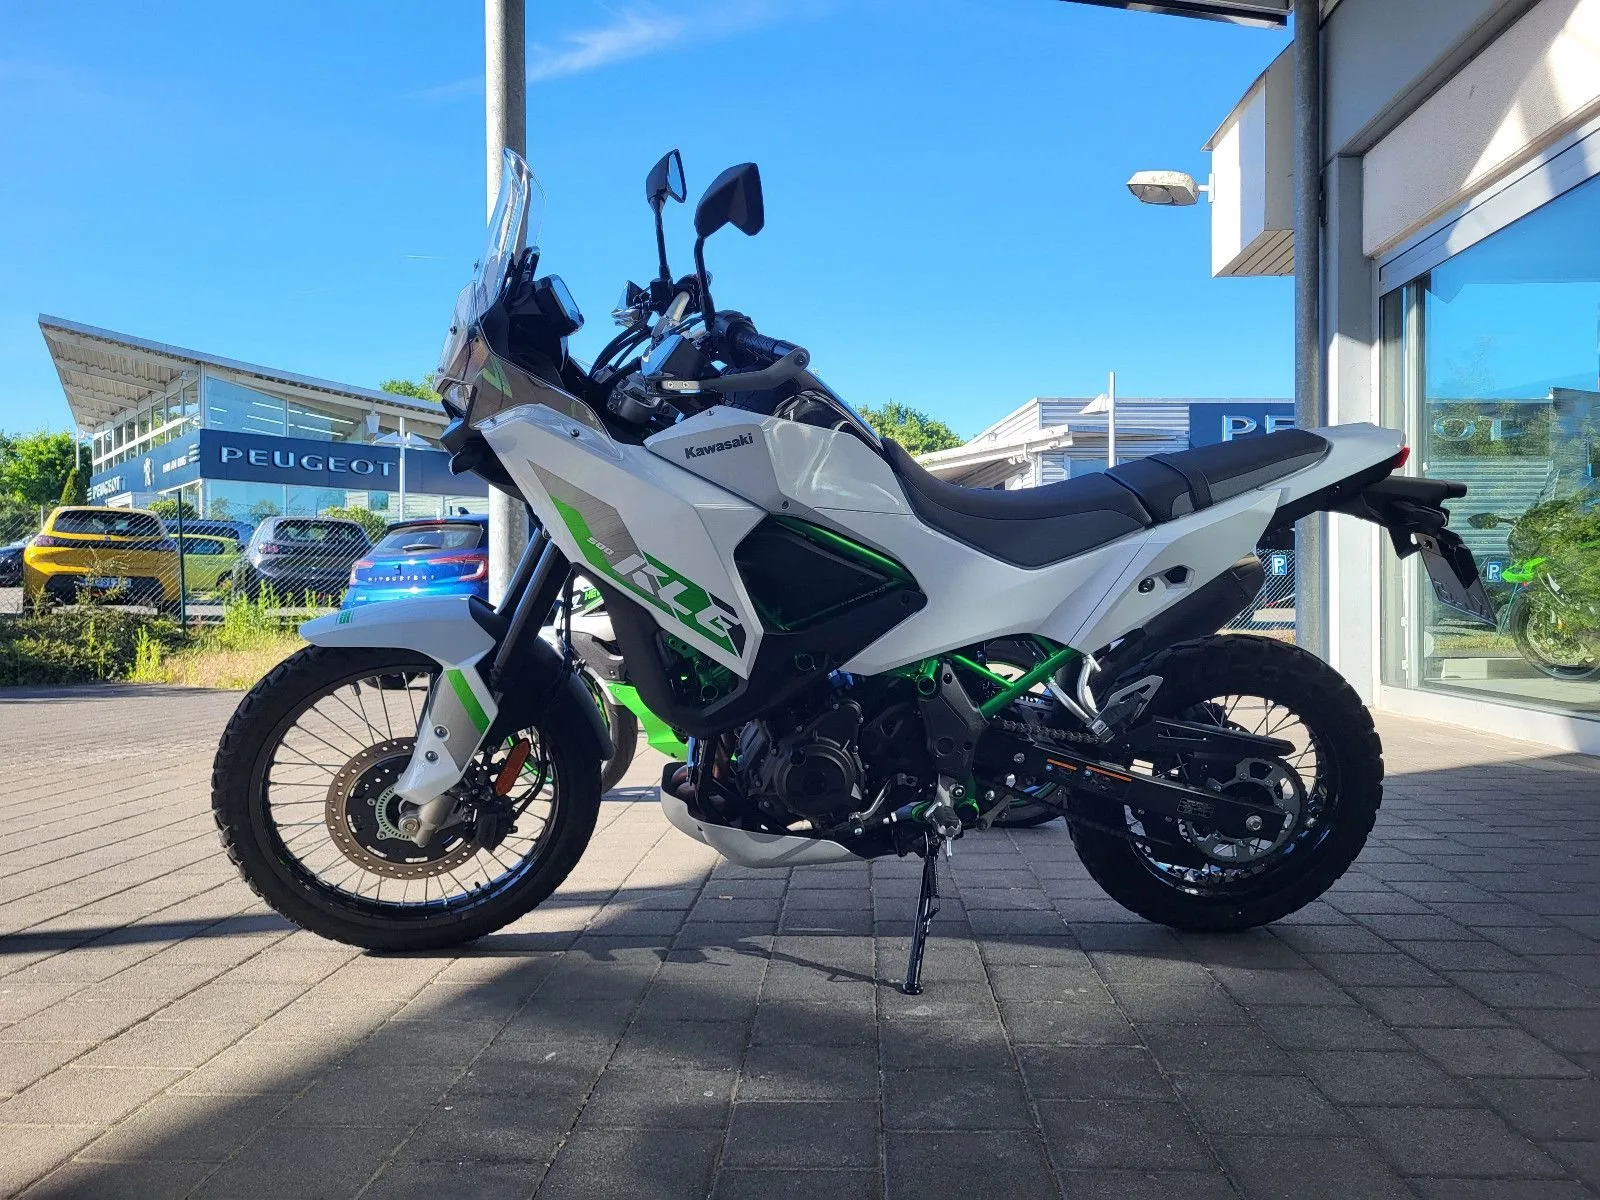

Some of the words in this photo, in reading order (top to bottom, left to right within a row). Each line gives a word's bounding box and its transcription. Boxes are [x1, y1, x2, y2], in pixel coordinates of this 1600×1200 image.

[685, 432, 753, 460] Kawasaki
[220, 446, 396, 477] PEUGEOT
[586, 536, 615, 556] 500
[1273, 557, 1285, 574] P
[1488, 564, 1500, 580] P
